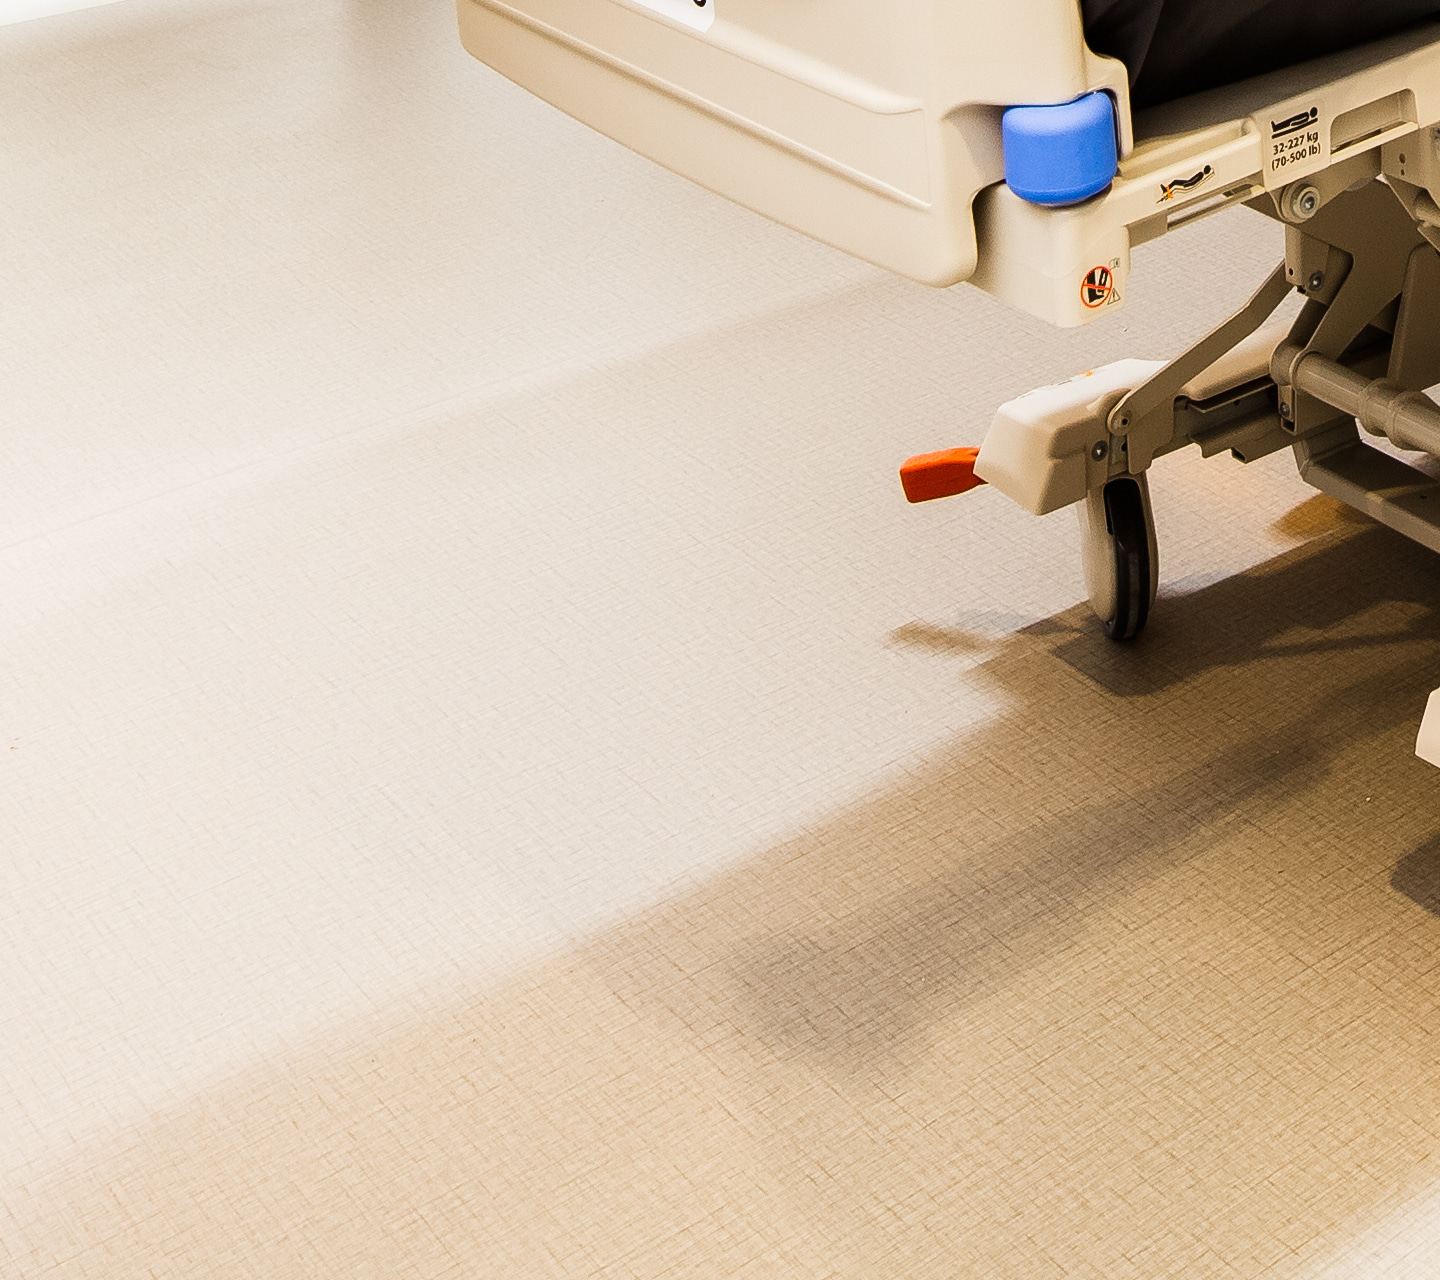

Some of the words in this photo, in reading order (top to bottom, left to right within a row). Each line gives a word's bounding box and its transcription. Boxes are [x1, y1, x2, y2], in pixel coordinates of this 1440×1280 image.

[1273, 134, 1305, 155] 32-227
[1307, 132, 1318, 143] kg
[1271, 148, 1307, 172] (70-500
[1309, 142, 1321, 156] lb)
